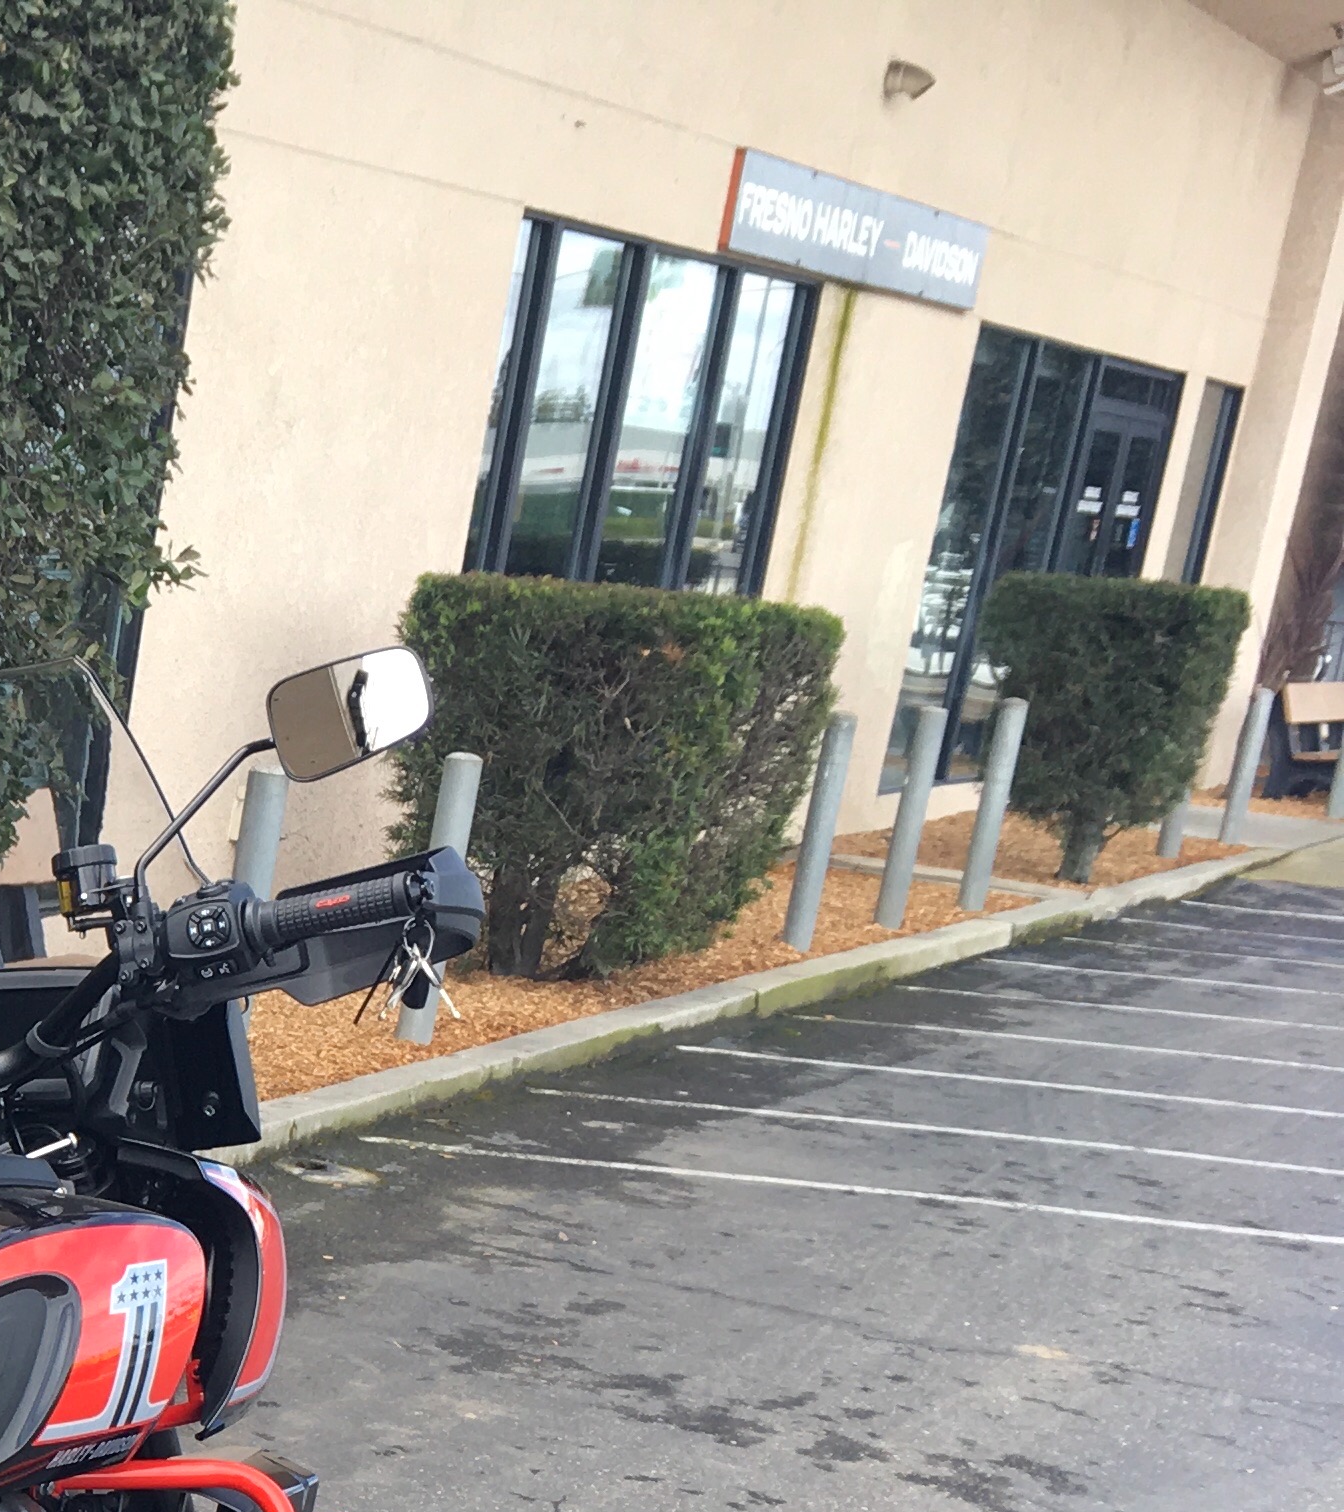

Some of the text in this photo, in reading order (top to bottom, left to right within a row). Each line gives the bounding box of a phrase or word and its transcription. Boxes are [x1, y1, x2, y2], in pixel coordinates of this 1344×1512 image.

[737, 181, 813, 241] FRESNO
[812, 203, 885, 257] HARLEY
[901, 230, 980, 287] DAVIDSON
